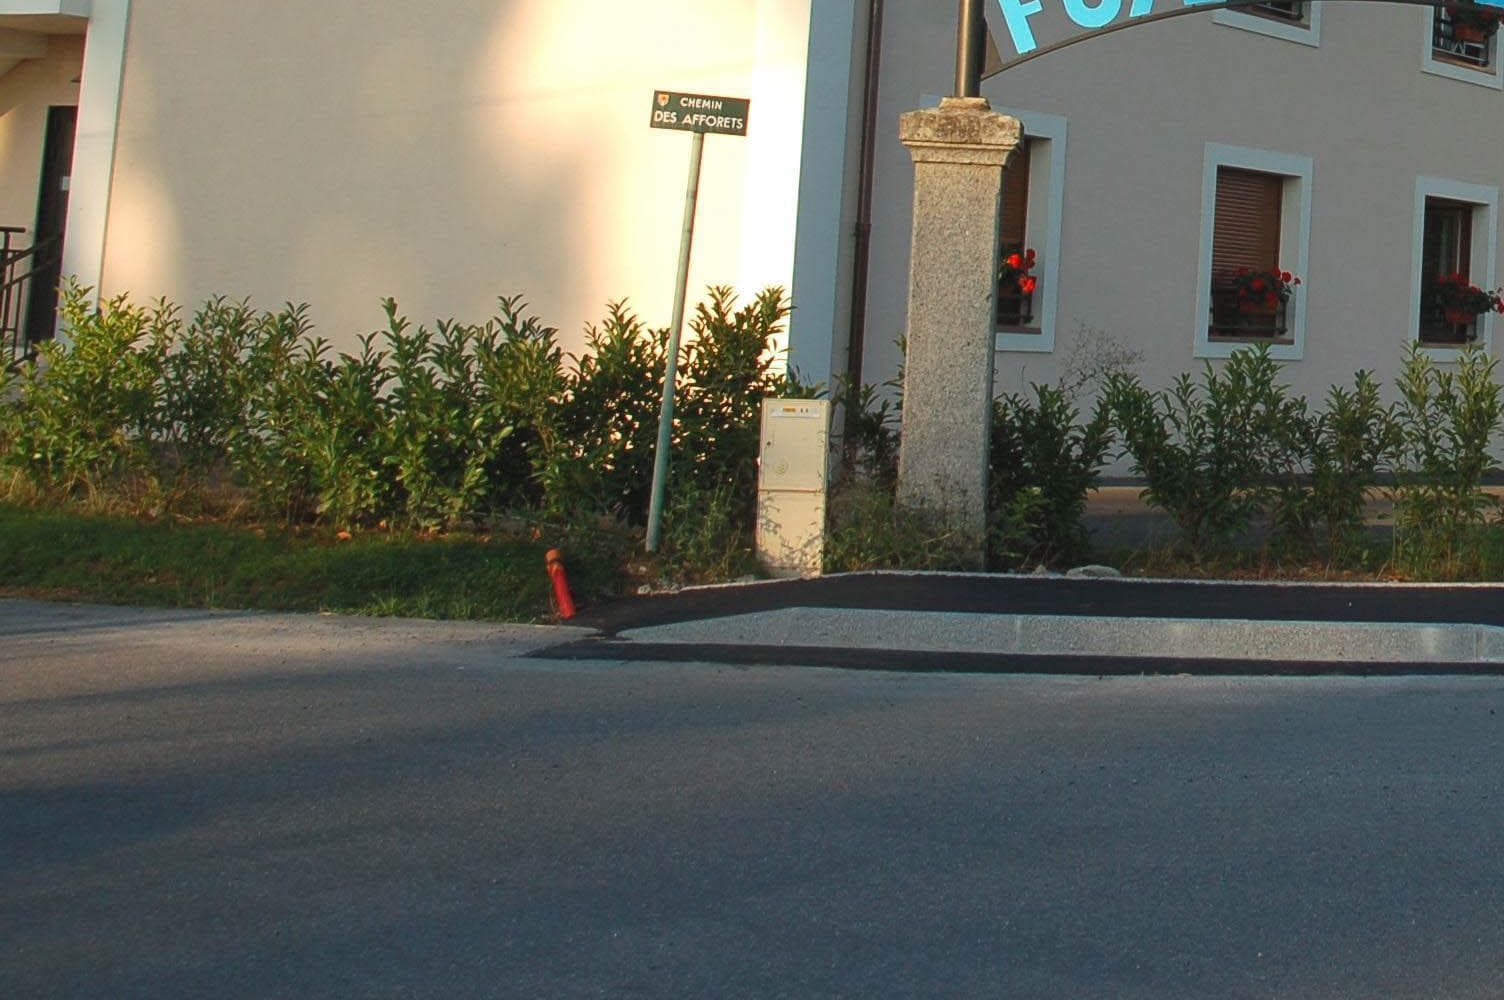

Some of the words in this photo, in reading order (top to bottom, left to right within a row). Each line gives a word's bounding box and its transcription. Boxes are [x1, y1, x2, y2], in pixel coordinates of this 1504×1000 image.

[680, 97, 723, 110] CHEMIN
[654, 111, 677, 123] DES
[682, 114, 743, 129] AFFORETS
